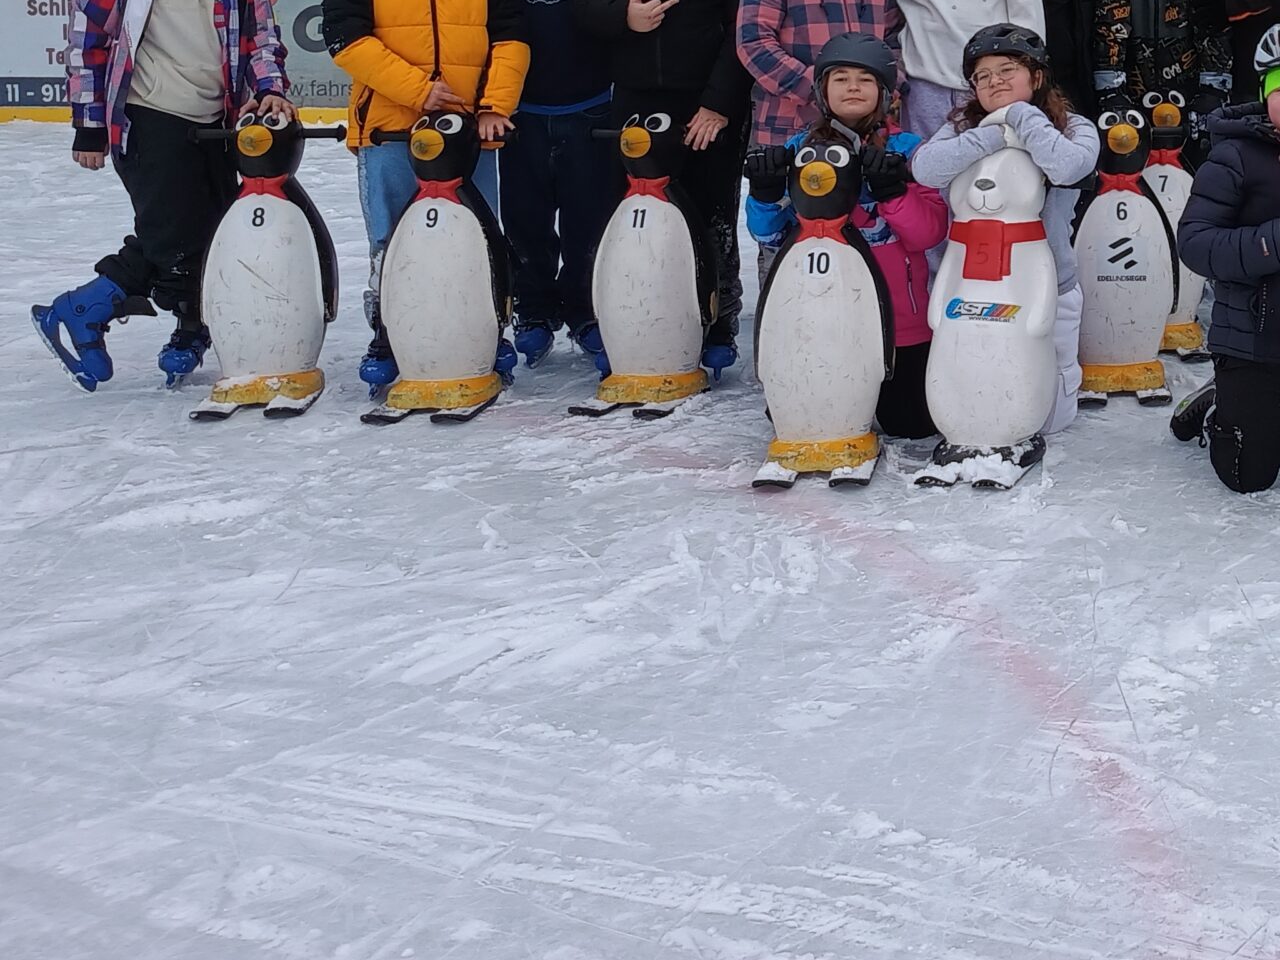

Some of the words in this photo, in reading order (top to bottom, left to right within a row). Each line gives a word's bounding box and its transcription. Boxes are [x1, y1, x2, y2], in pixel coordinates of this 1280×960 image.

[1158, 175, 1168, 192] 7
[252, 207, 265, 227] 8
[426, 208, 438, 228] 9
[632, 209, 647, 228] 11
[1116, 201, 1128, 220] 6
[808, 252, 830, 274] 10
[976, 243, 990, 264] 5
[951, 302, 993, 316] AST
